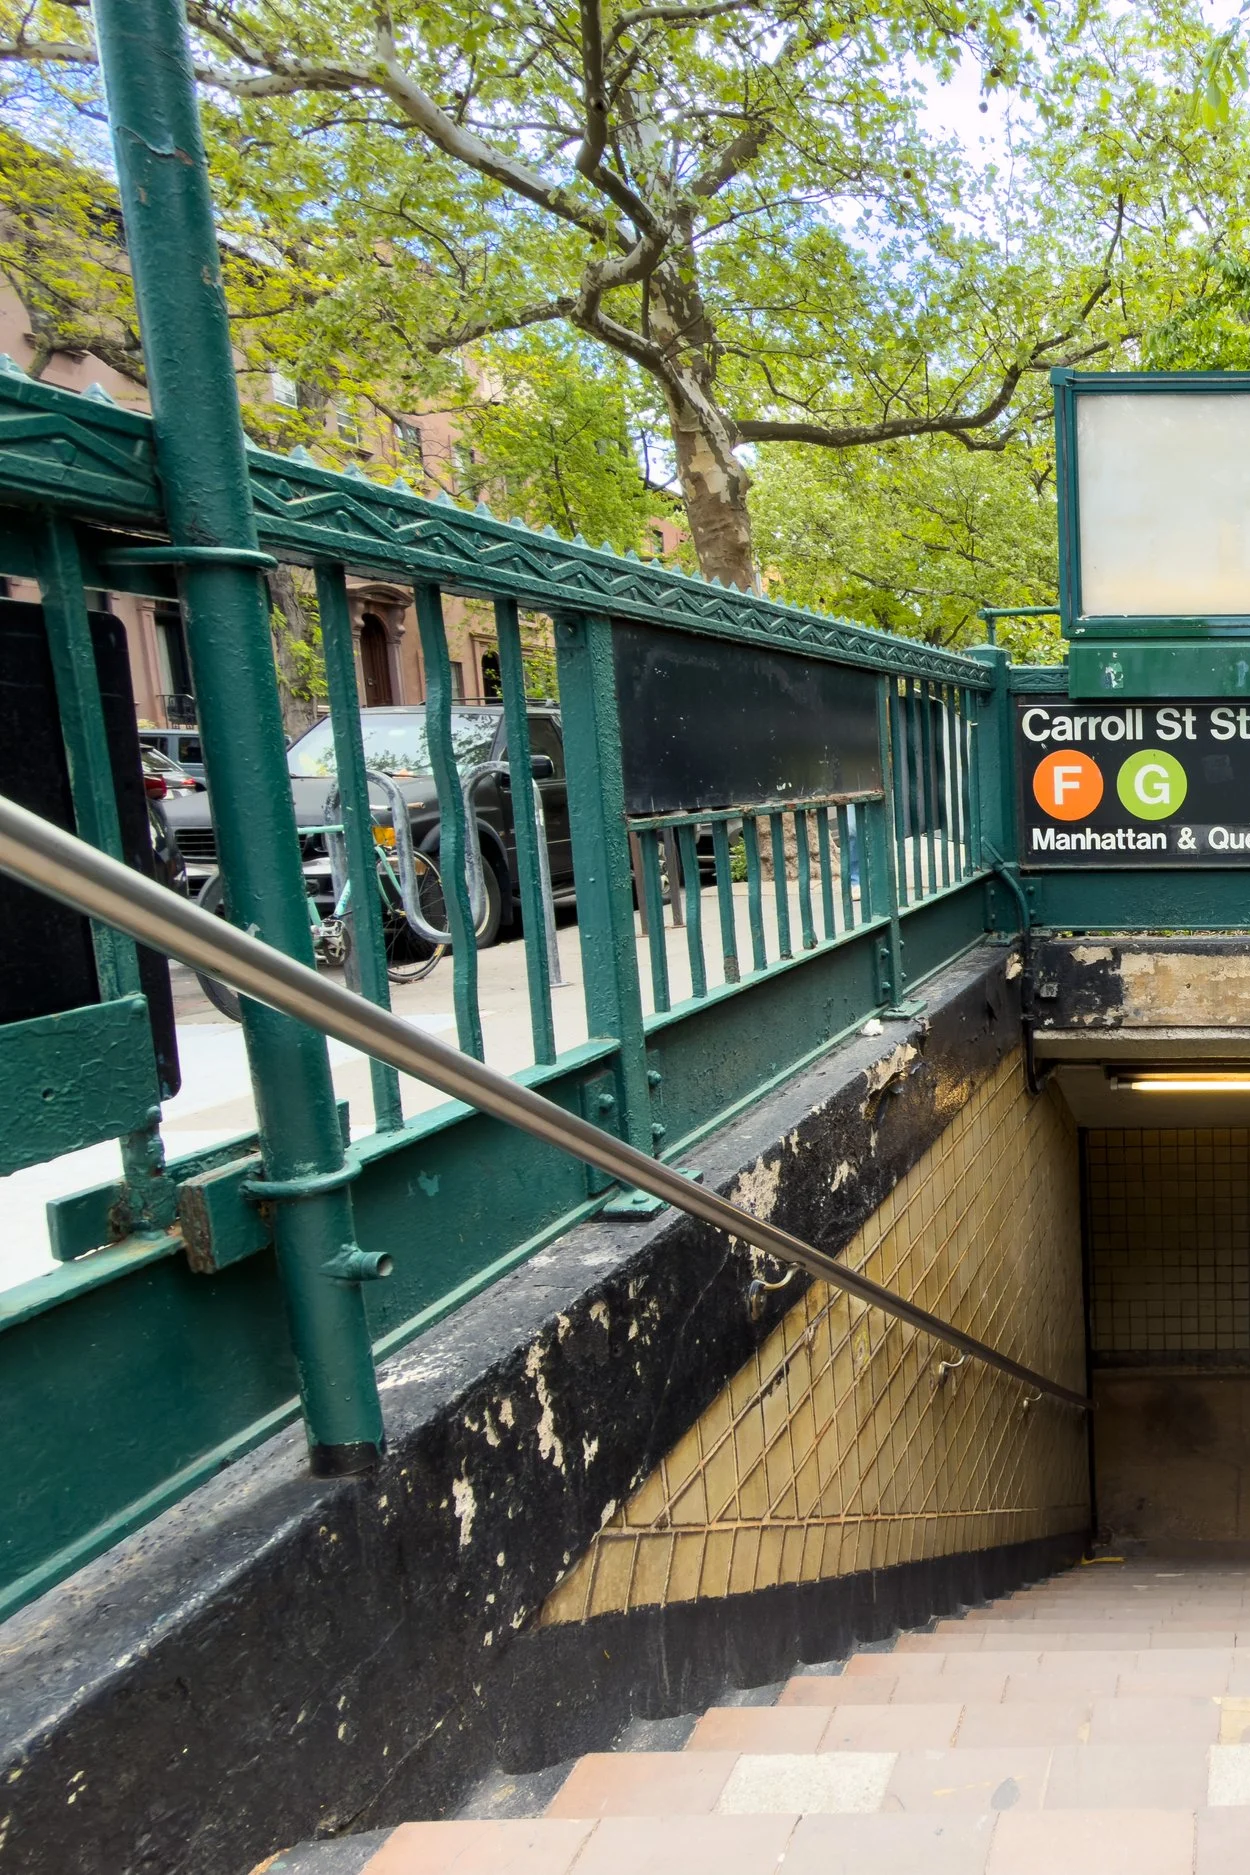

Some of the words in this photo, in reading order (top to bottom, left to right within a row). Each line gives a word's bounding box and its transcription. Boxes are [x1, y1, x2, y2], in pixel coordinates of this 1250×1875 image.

[1022, 708, 1143, 741] Carroll
[1156, 708, 1197, 740] St
[1053, 766, 1082, 805] F
[1134, 764, 1171, 805] G
[1033, 828, 1167, 851] Manhattan
[1177, 826, 1198, 850] &
